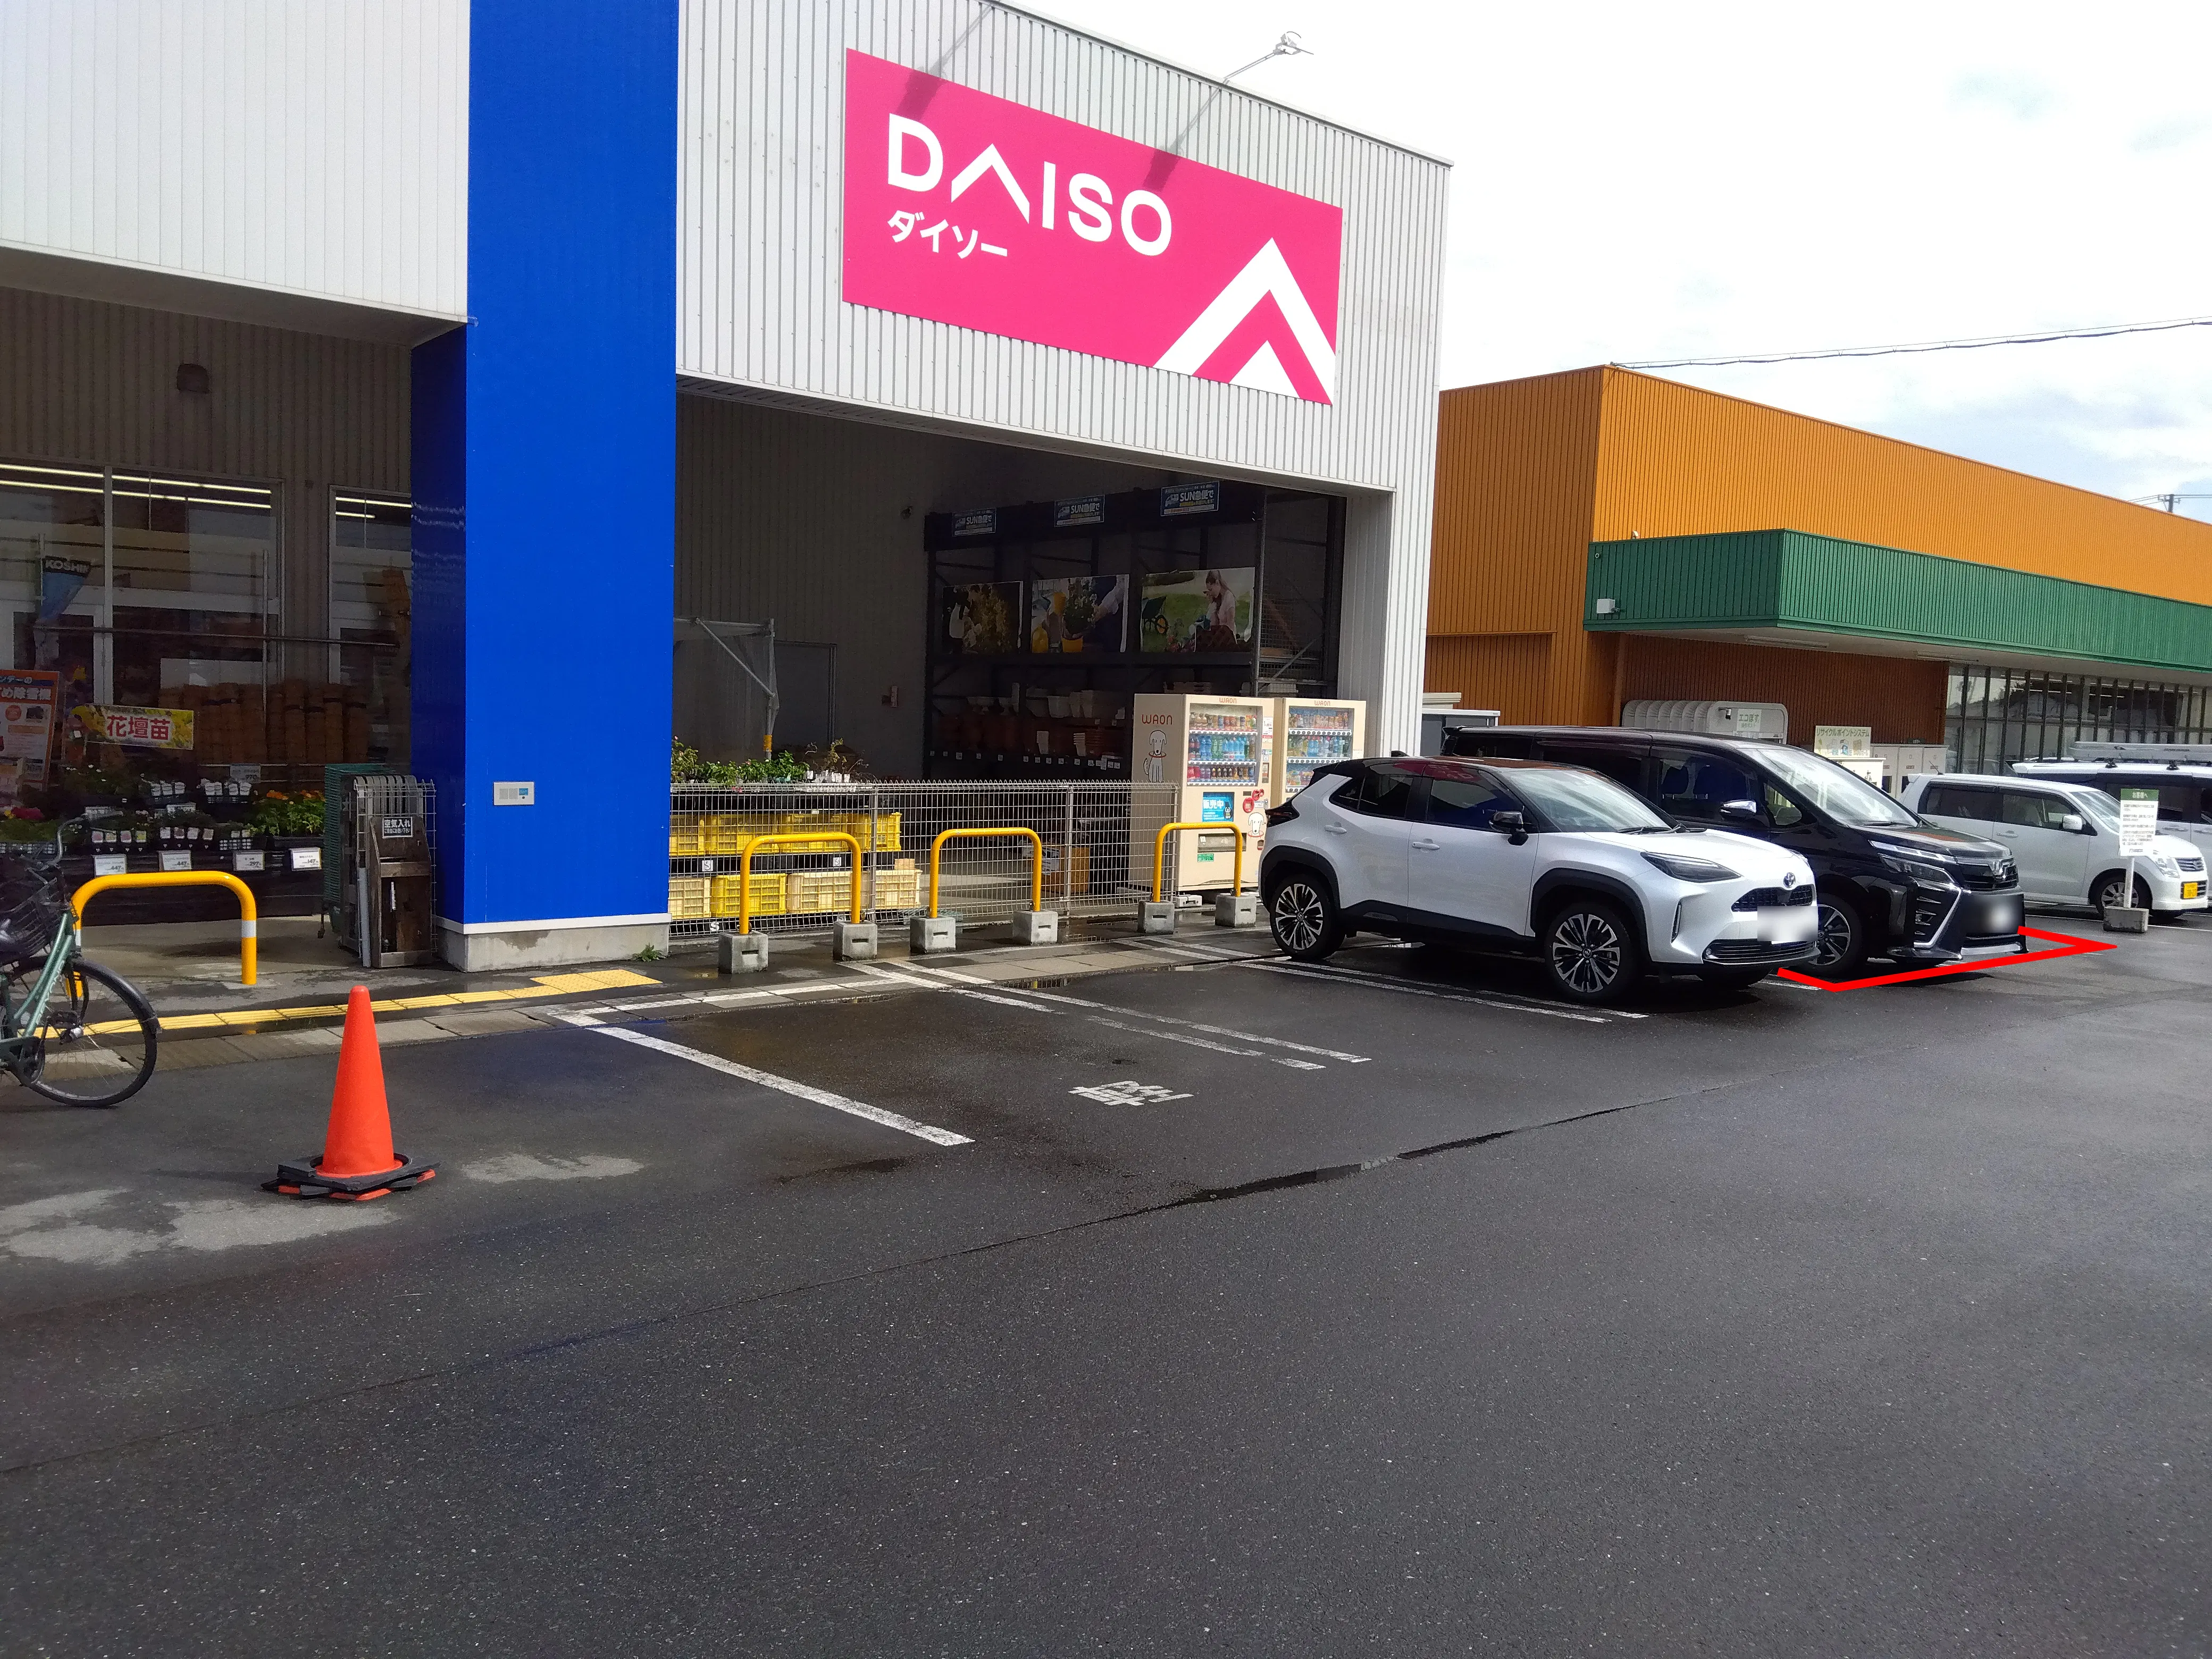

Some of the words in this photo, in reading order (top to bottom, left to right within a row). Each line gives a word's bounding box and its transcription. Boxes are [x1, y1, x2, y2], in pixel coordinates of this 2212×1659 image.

[888, 113, 1171, 255] DAISO
[887, 210, 1008, 258] ダイソー
[107, 715, 170, 741] 花壇苗
[1142, 714, 1172, 725] WAON
[384, 819, 410, 828] 空気入れ
